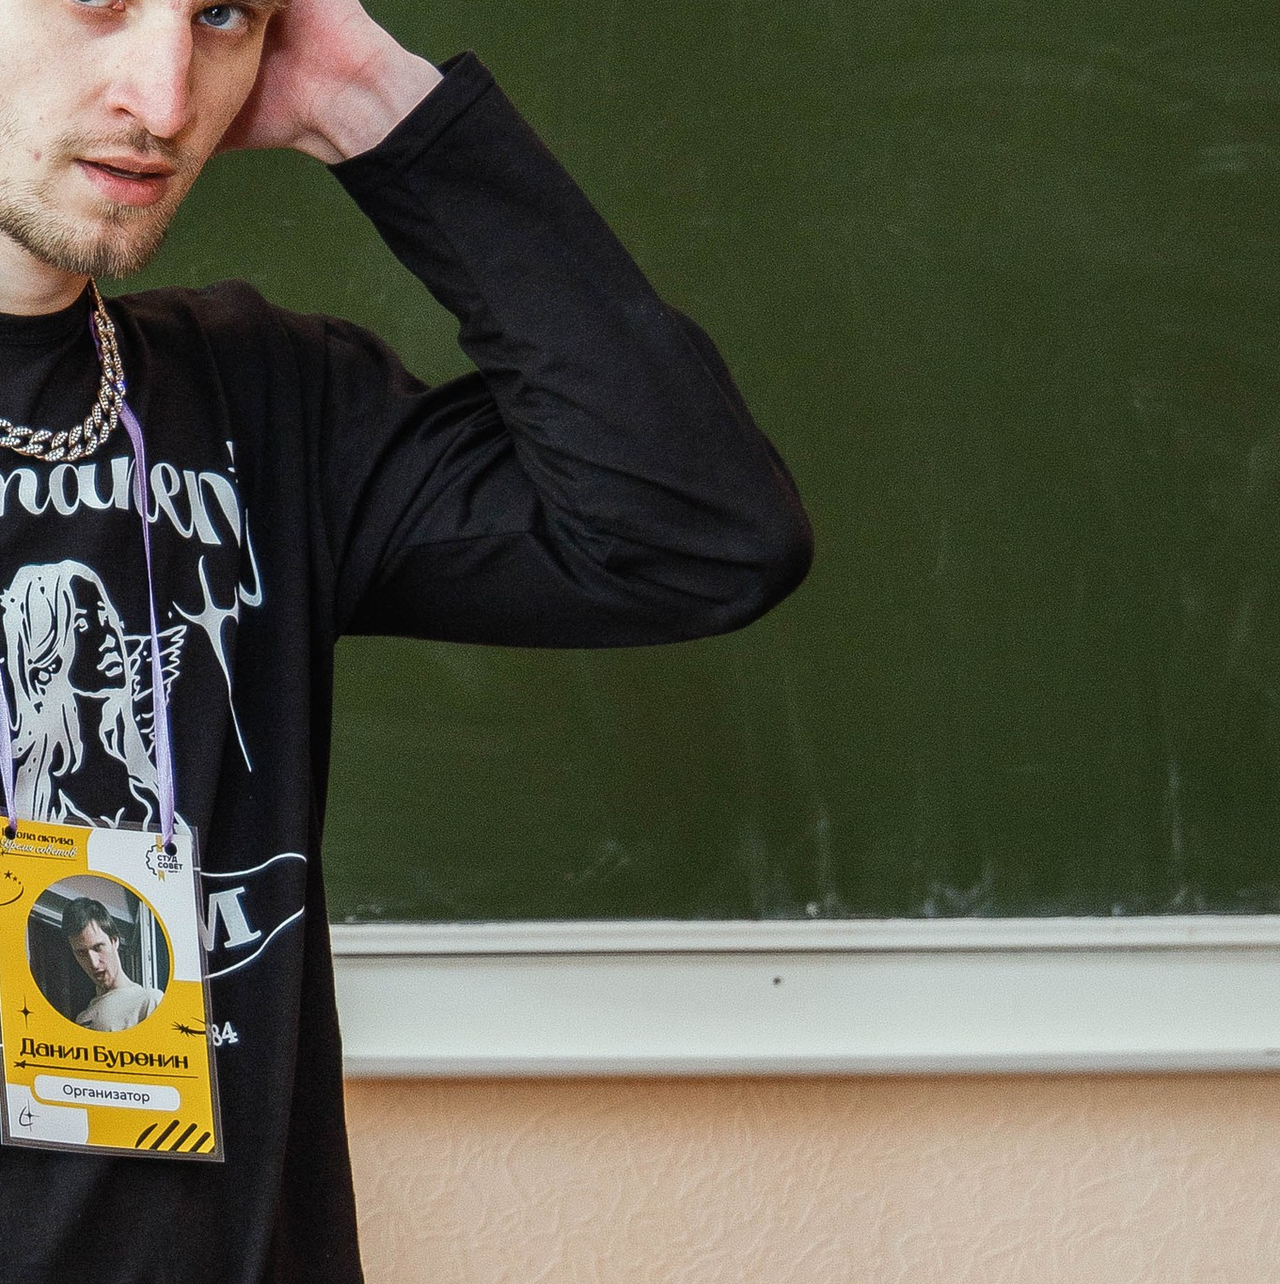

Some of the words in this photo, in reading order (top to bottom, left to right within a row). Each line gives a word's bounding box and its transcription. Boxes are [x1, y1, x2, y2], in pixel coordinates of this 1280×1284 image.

[2, 827, 36, 841] ола
[157, 862, 184, 870] СОВЕТ
[20, 1037, 88, 1061] Данил
[62, 1084, 151, 1105] Организатор
